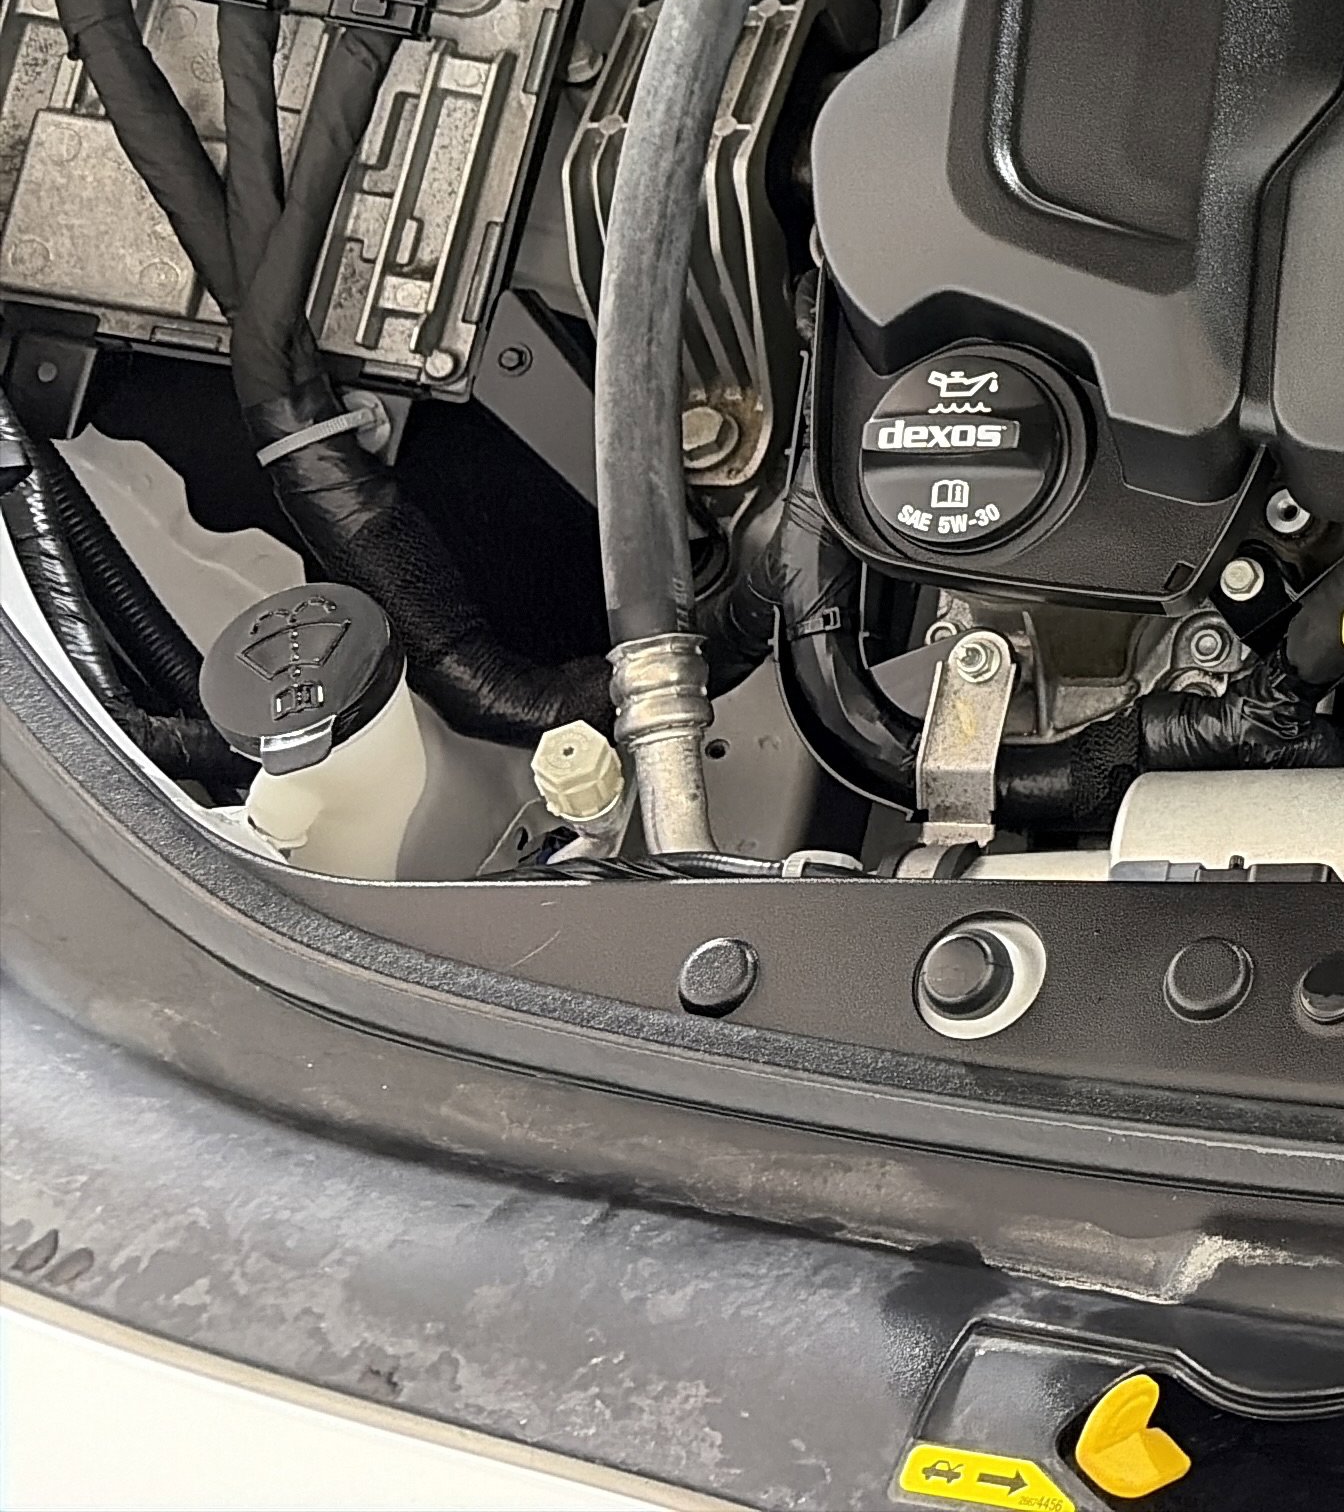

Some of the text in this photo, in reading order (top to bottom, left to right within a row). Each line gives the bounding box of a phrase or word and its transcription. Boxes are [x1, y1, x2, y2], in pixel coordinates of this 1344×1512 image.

[877, 420, 1002, 449] dexos
[897, 503, 1001, 534] SAE 5W-30
